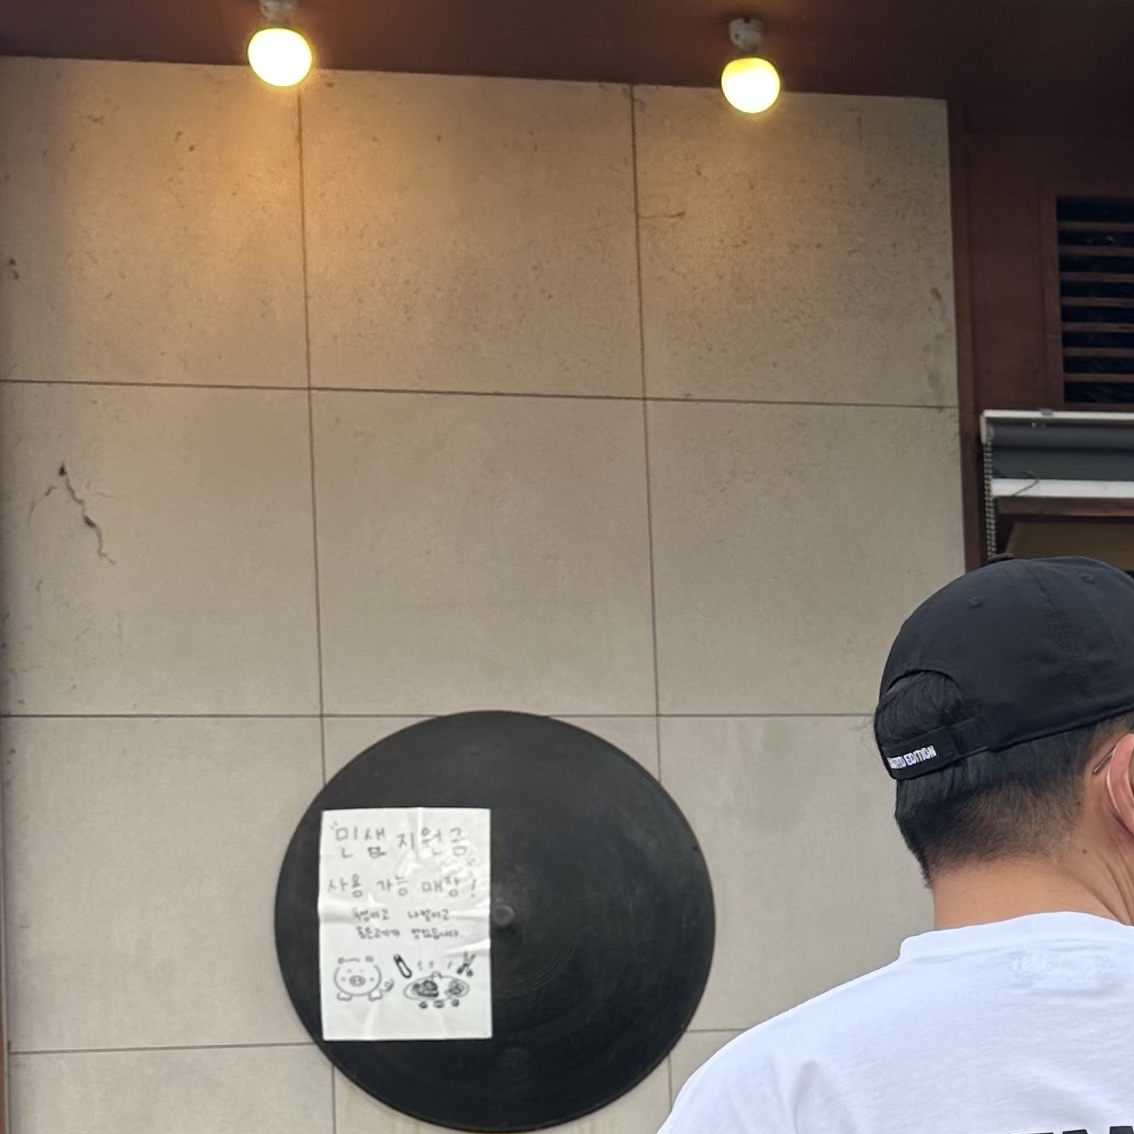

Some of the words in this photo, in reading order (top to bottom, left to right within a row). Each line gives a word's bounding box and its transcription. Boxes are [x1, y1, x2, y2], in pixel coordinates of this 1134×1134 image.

[903, 745, 937, 766] EDITION
[328, 873, 363, 899] 사용
[376, 875, 409, 897] 가능
